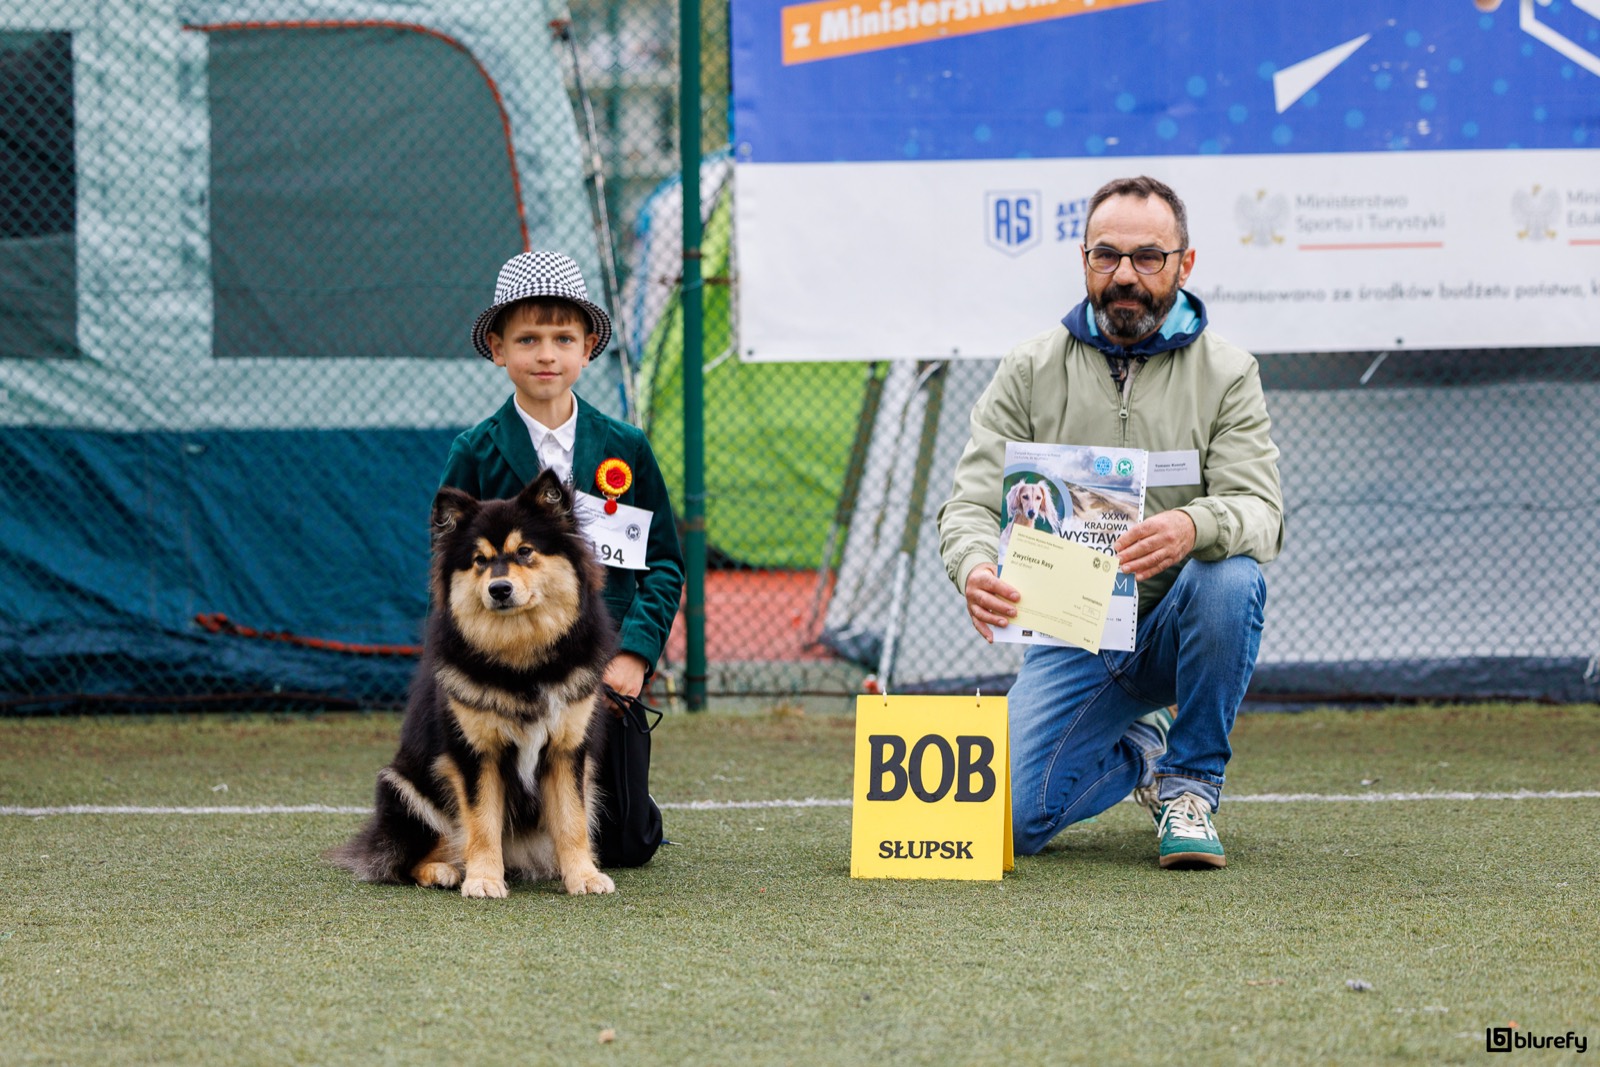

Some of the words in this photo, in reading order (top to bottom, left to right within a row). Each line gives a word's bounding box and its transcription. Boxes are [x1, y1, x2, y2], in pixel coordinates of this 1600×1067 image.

[791, 22, 812, 48] z
[818, 0, 1059, 44] Ministerstw
[1296, 194, 1408, 210] Ministerstwo
[996, 200, 1032, 245] AS
[1296, 214, 1350, 233] Sportu
[1369, 212, 1446, 232] Turystyki
[1333, 287, 1352, 300] ze
[1359, 282, 1434, 300] środków
[1439, 280, 1510, 299] budżetu
[1101, 512, 1129, 521] XXXVI
[1084, 521, 1128, 532] KRAJOWA
[1058, 528, 1121, 545] WYSTAW
[592, 541, 625, 565] 194
[1041, 559, 1054, 570] Rasy
[866, 734, 997, 803] BOB
[878, 840, 974, 859] SŁUPSK
